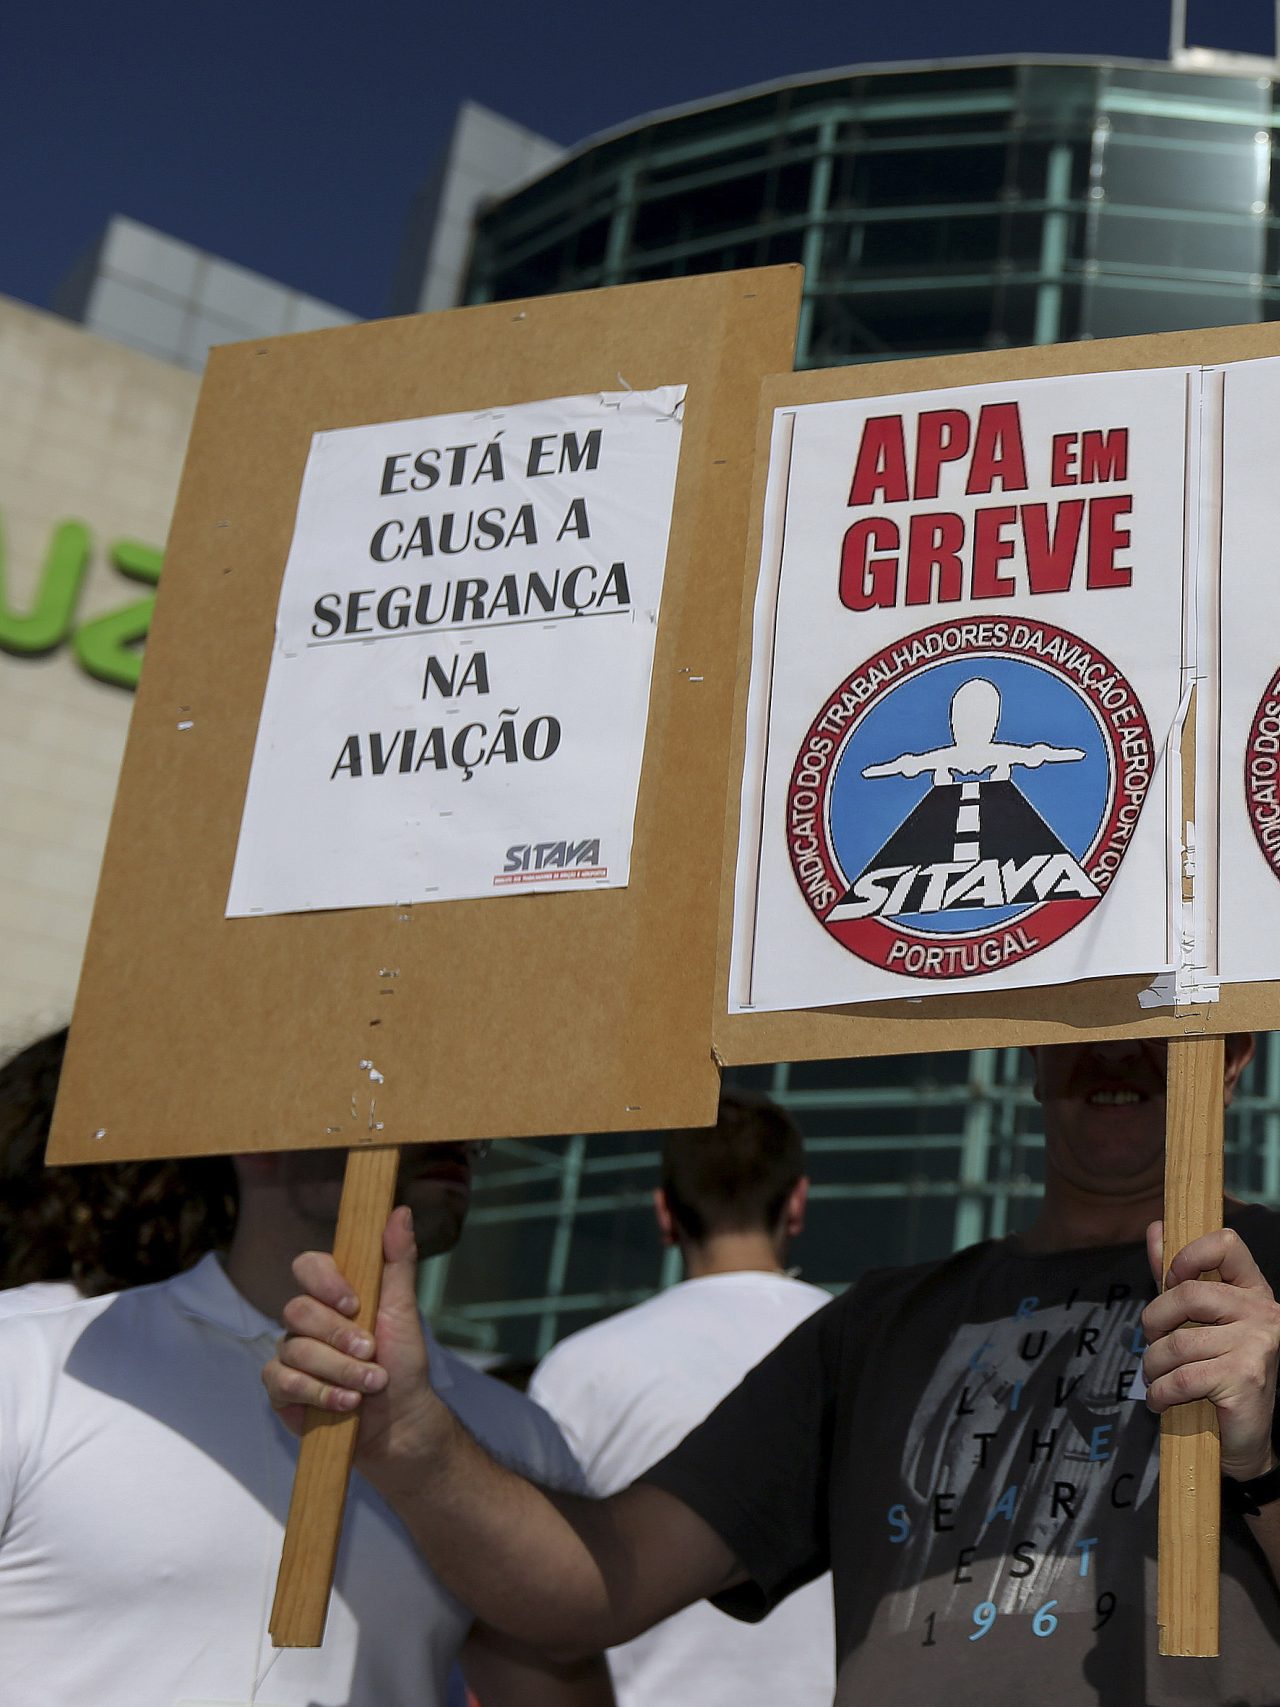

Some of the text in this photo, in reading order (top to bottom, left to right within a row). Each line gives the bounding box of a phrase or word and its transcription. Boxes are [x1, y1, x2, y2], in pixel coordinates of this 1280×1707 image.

[379, 429, 603, 496] ESTÁ EM
[847, 401, 1129, 506] APA EM
[369, 497, 592, 563] CAUSA A
[838, 494, 1134, 612] GREVE
[311, 561, 632, 639] SEGURANÇA
[421, 650, 491, 700] NA
[817, 623, 1009, 735] TRABALHADORES
[329, 706, 562, 782] AVIAÇÃO
[1110, 703, 1139, 727] E
[796, 736, 834, 788] DOS
[1089, 725, 1150, 888] AEROPORTOS
[503, 838, 601, 872] SITAVA
[793, 791, 837, 910] SINDICATO
[824, 853, 1102, 923] SITAVA
[886, 927, 1040, 974] PORTUGAL
[886, 1473, 1136, 1545] SEARC
[920, 1591, 1118, 1648] 1969
